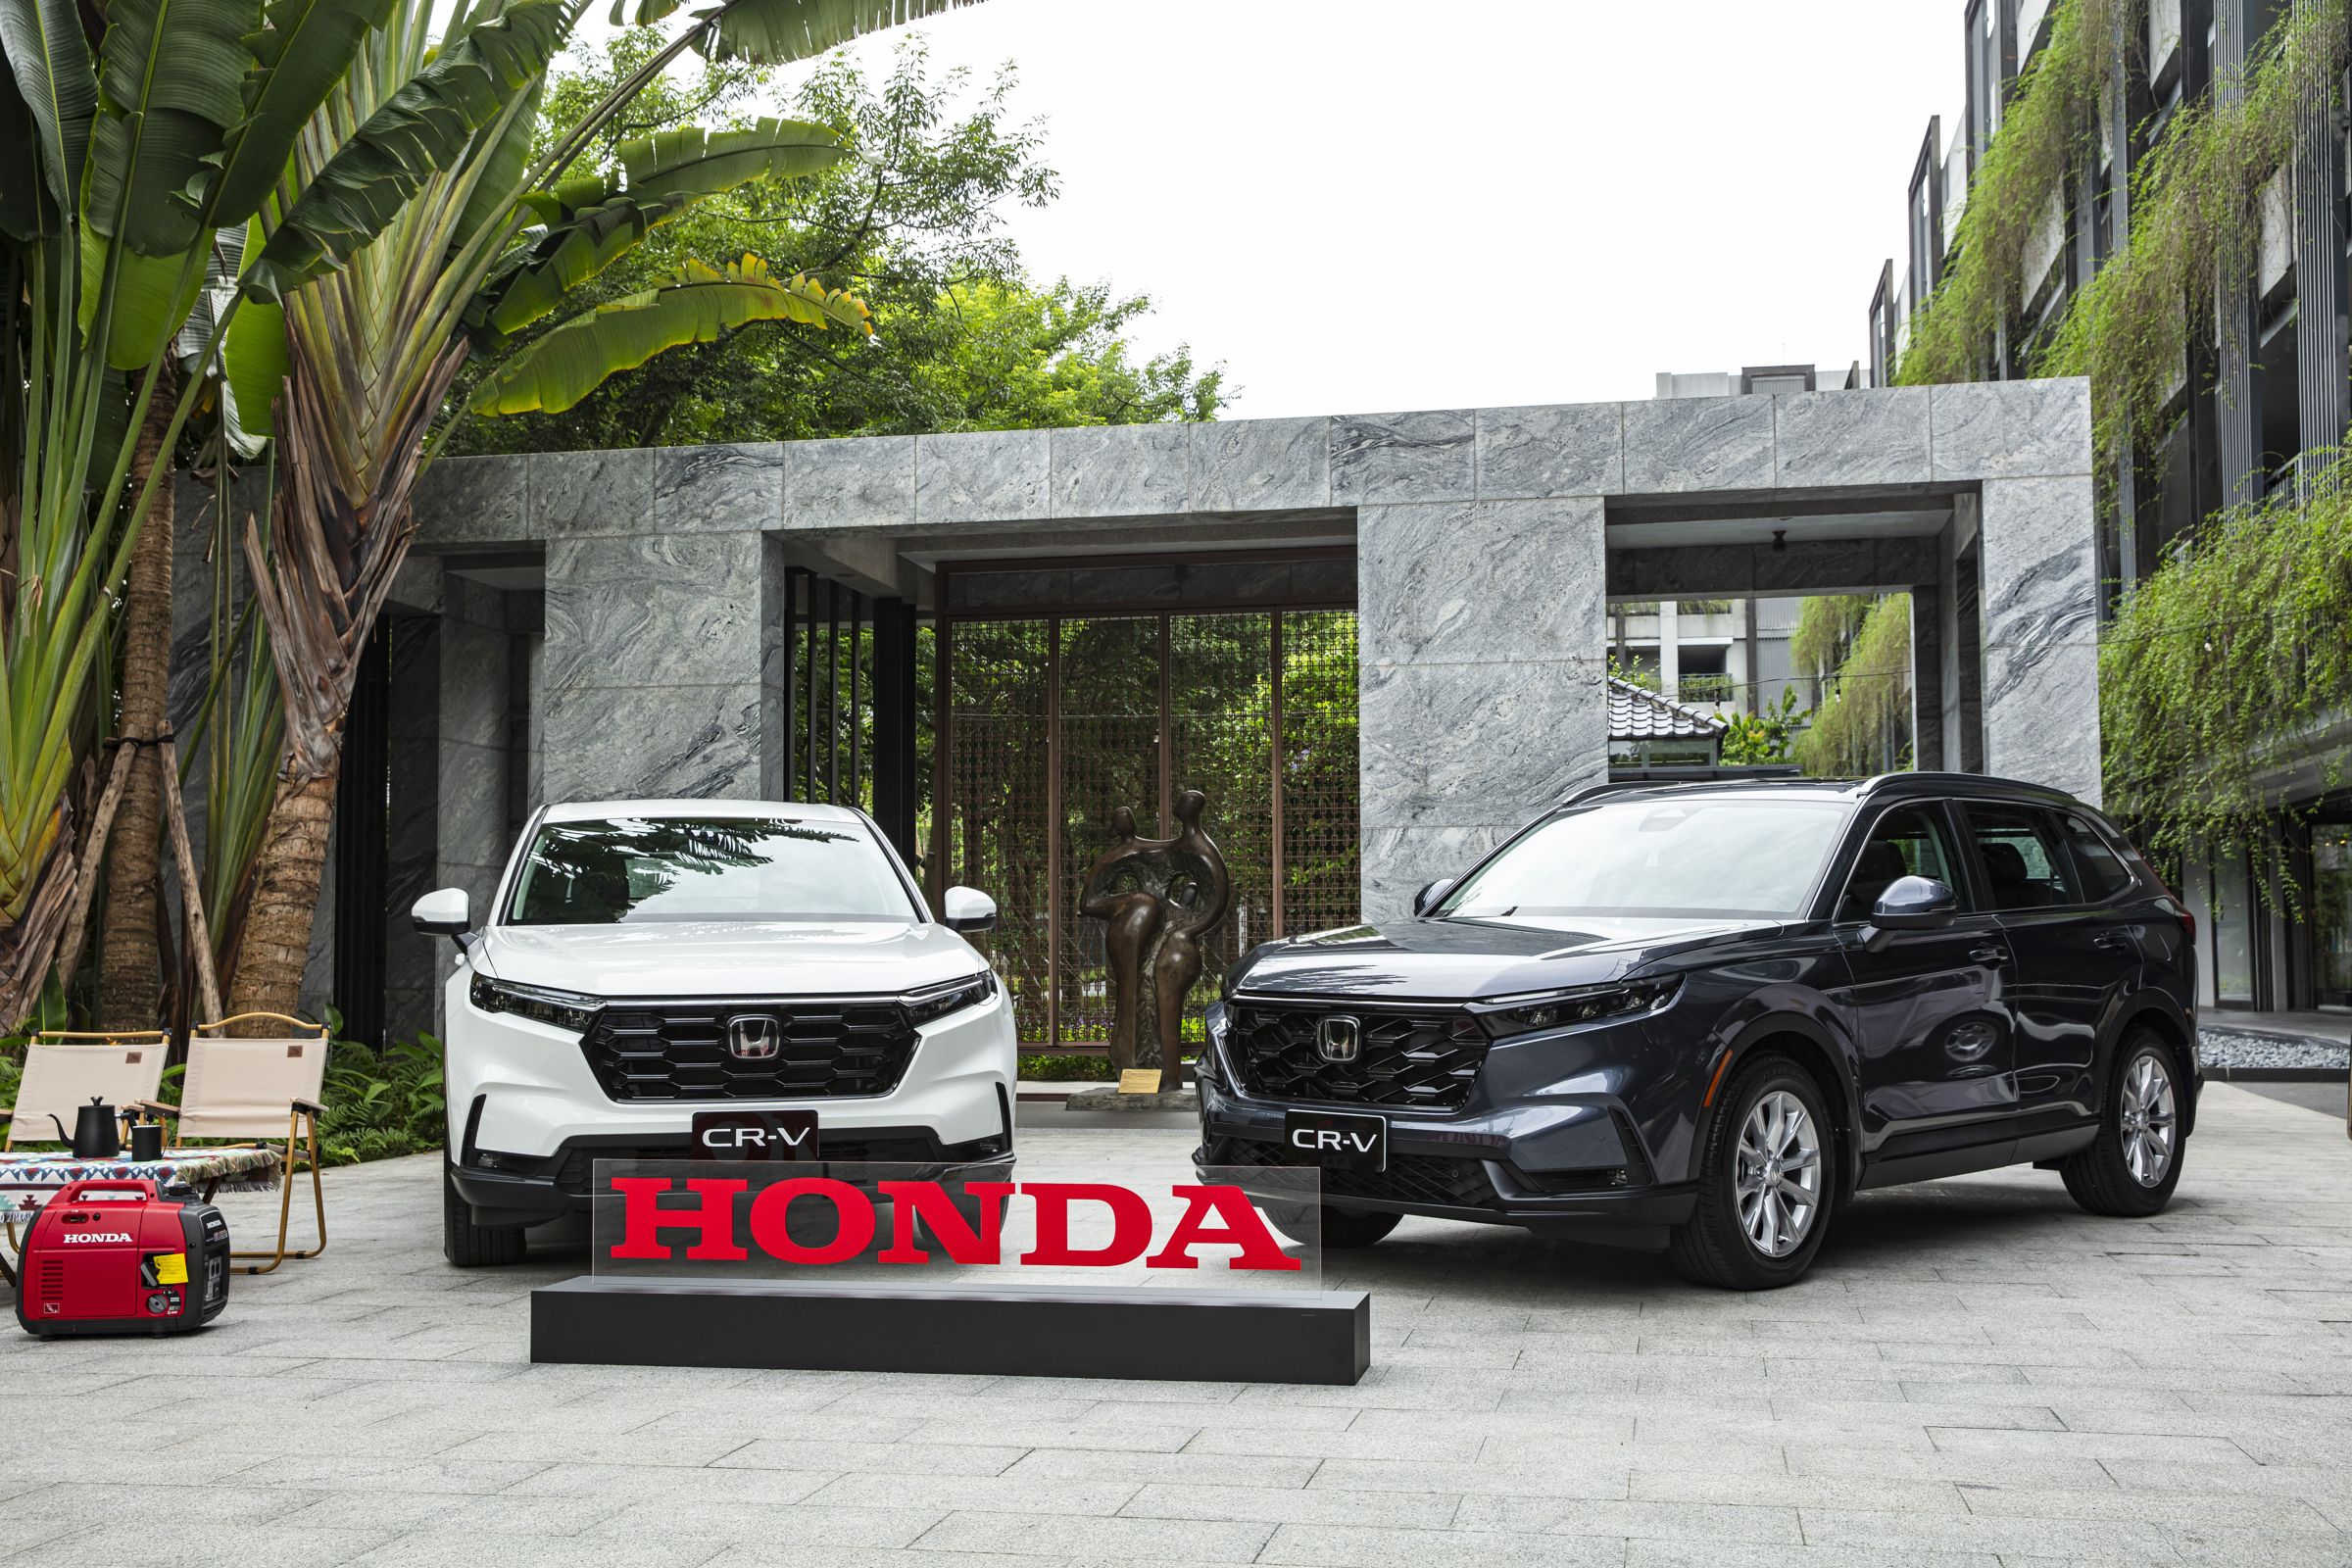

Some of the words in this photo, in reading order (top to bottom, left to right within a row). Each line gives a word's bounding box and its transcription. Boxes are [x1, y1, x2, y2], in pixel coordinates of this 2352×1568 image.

[702, 1127, 810, 1148] CR-V
[1292, 1128, 1377, 1152] CR-V
[611, 1177, 1301, 1271] HONDA
[63, 1232, 133, 1244] HONDA
